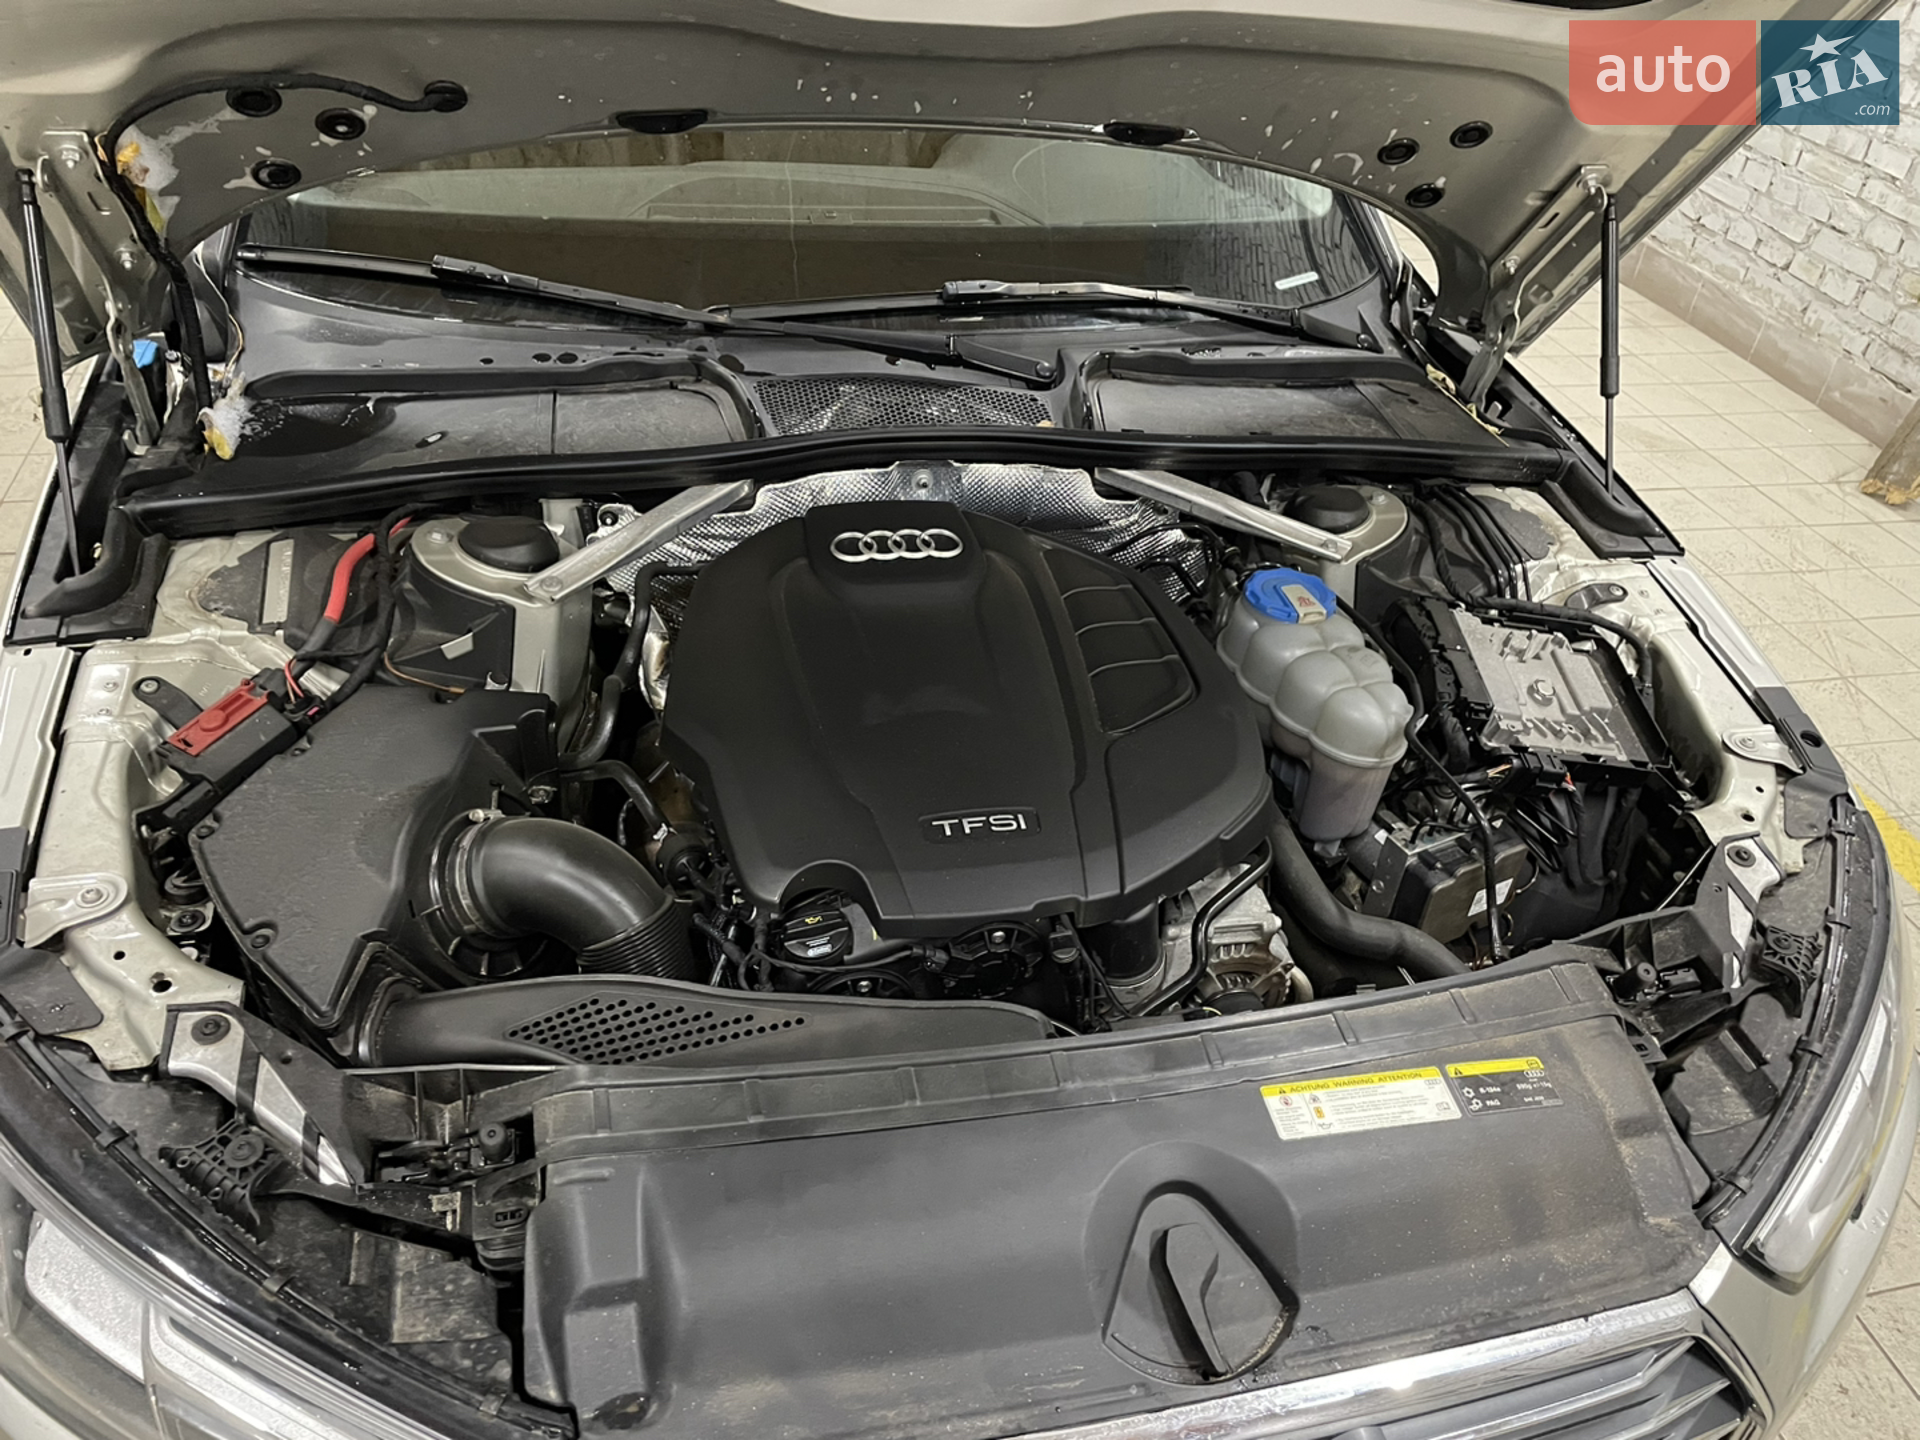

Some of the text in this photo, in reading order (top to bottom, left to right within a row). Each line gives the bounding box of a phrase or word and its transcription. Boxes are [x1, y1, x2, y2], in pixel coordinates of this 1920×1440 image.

[931, 813, 1027, 836] TFSI
[1289, 1072, 1423, 1093] ACHTUNG WARNING ATTENTION
